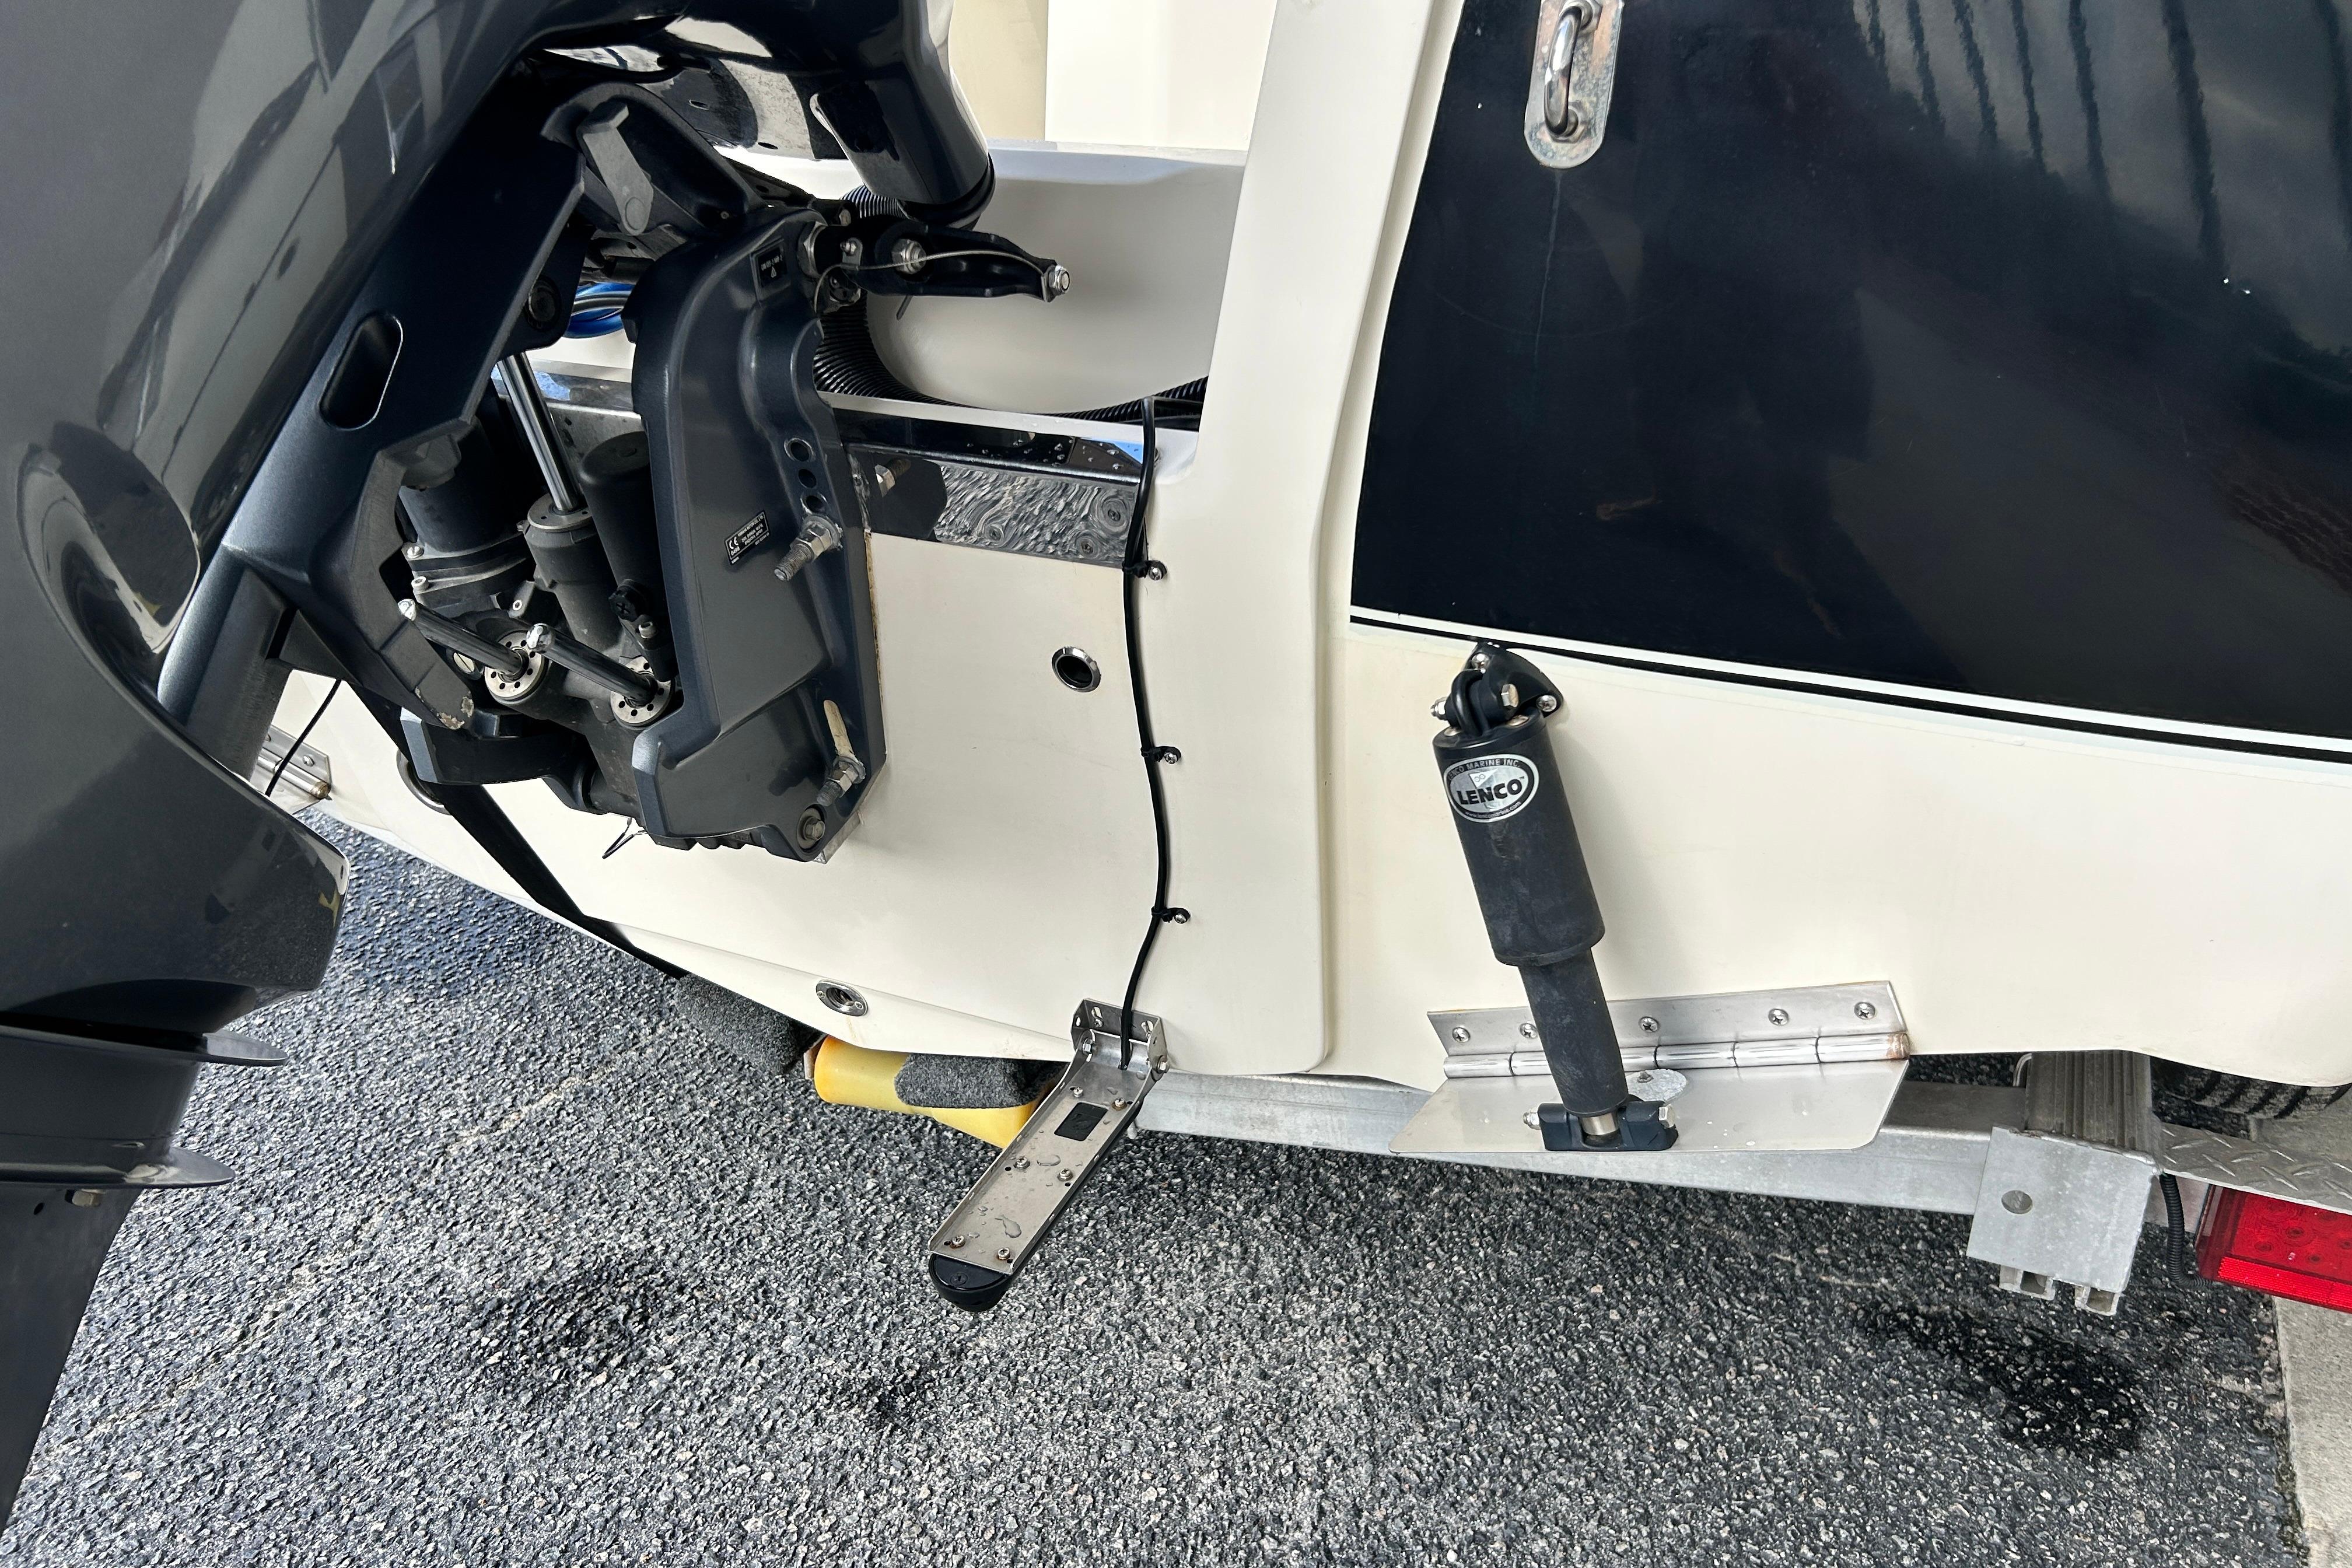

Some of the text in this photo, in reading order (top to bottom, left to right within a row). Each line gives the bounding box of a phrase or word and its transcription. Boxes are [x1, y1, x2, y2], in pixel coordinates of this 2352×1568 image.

[1466, 758, 1500, 770] MARINE
[1503, 758, 1520, 768] INC.
[1457, 779, 1522, 804] LENCO
